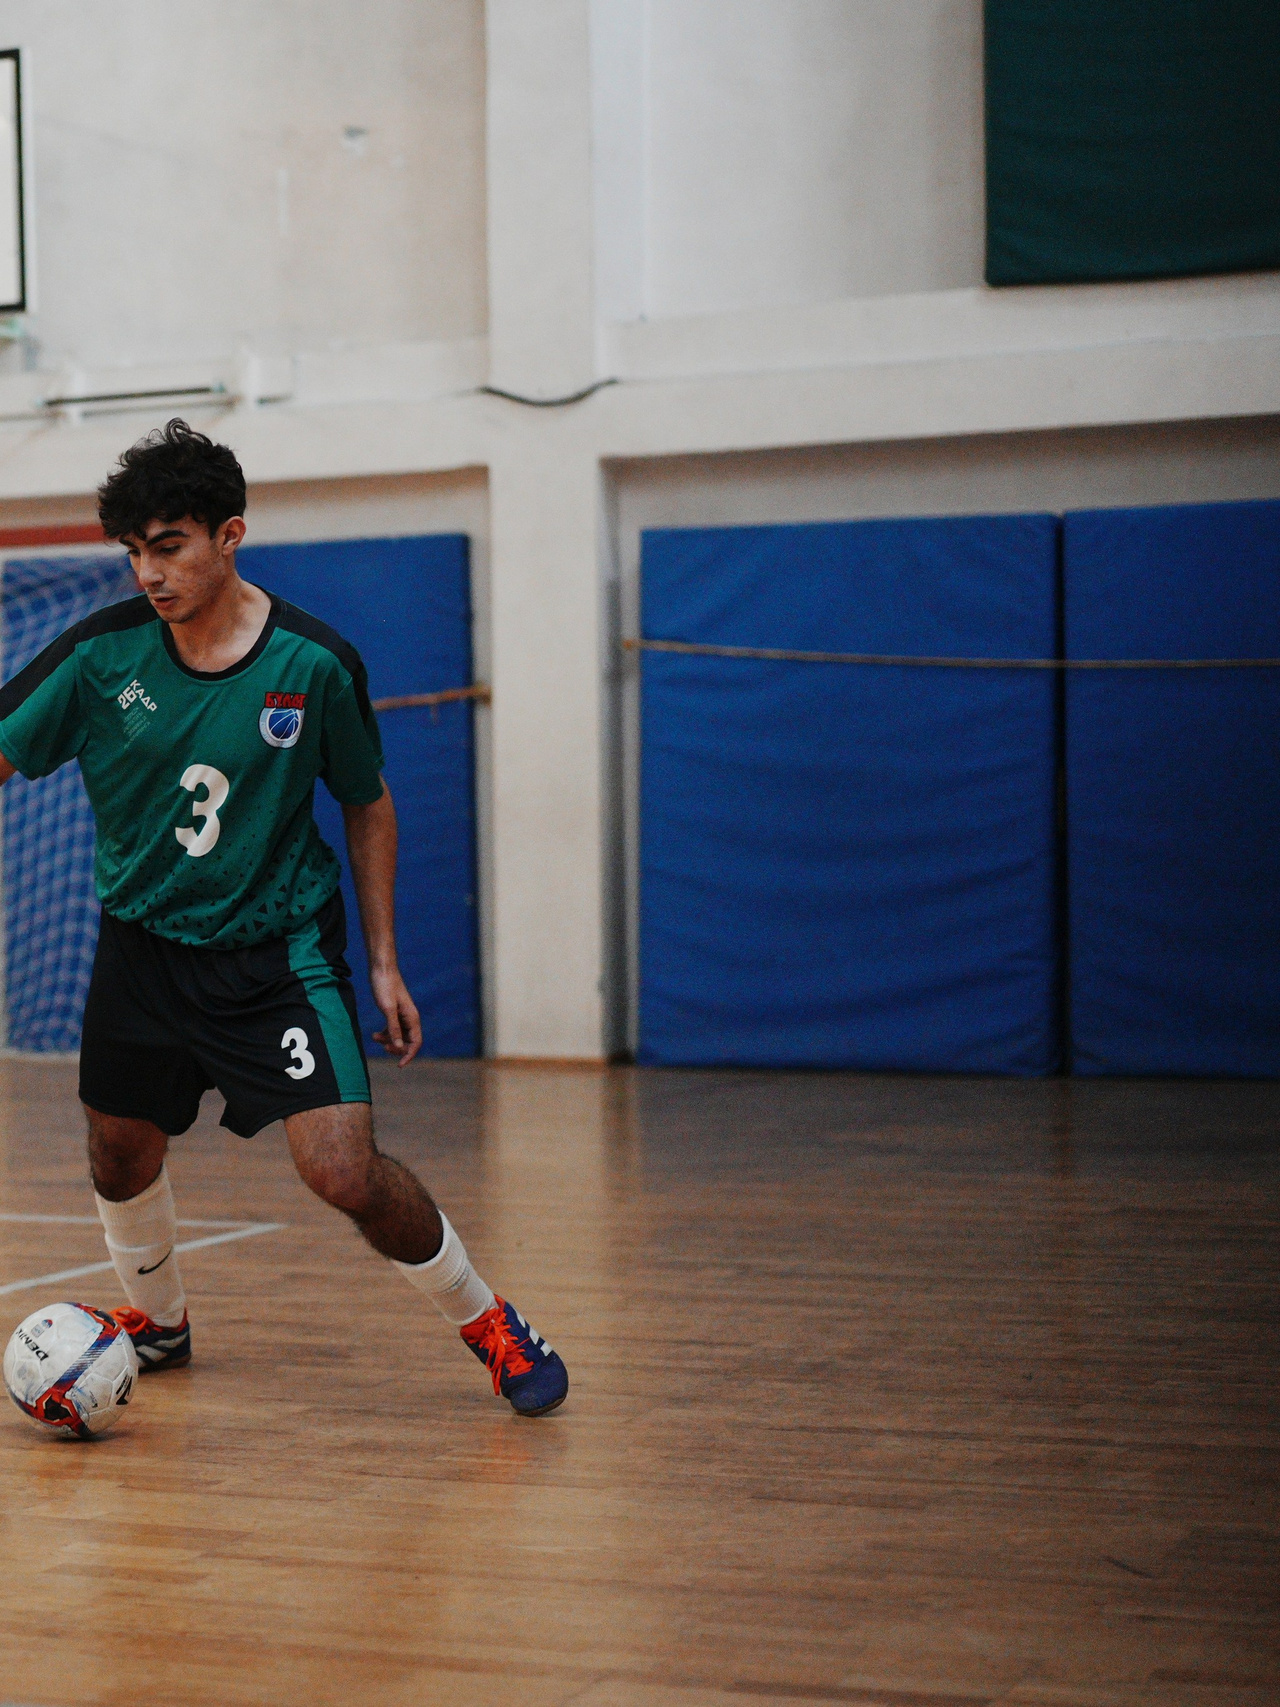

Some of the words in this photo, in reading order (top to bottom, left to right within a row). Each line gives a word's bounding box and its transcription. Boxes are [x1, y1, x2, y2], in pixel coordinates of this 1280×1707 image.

[117, 686, 138, 710] 26
[175, 763, 229, 858] 3
[280, 1026, 316, 1080] 3
